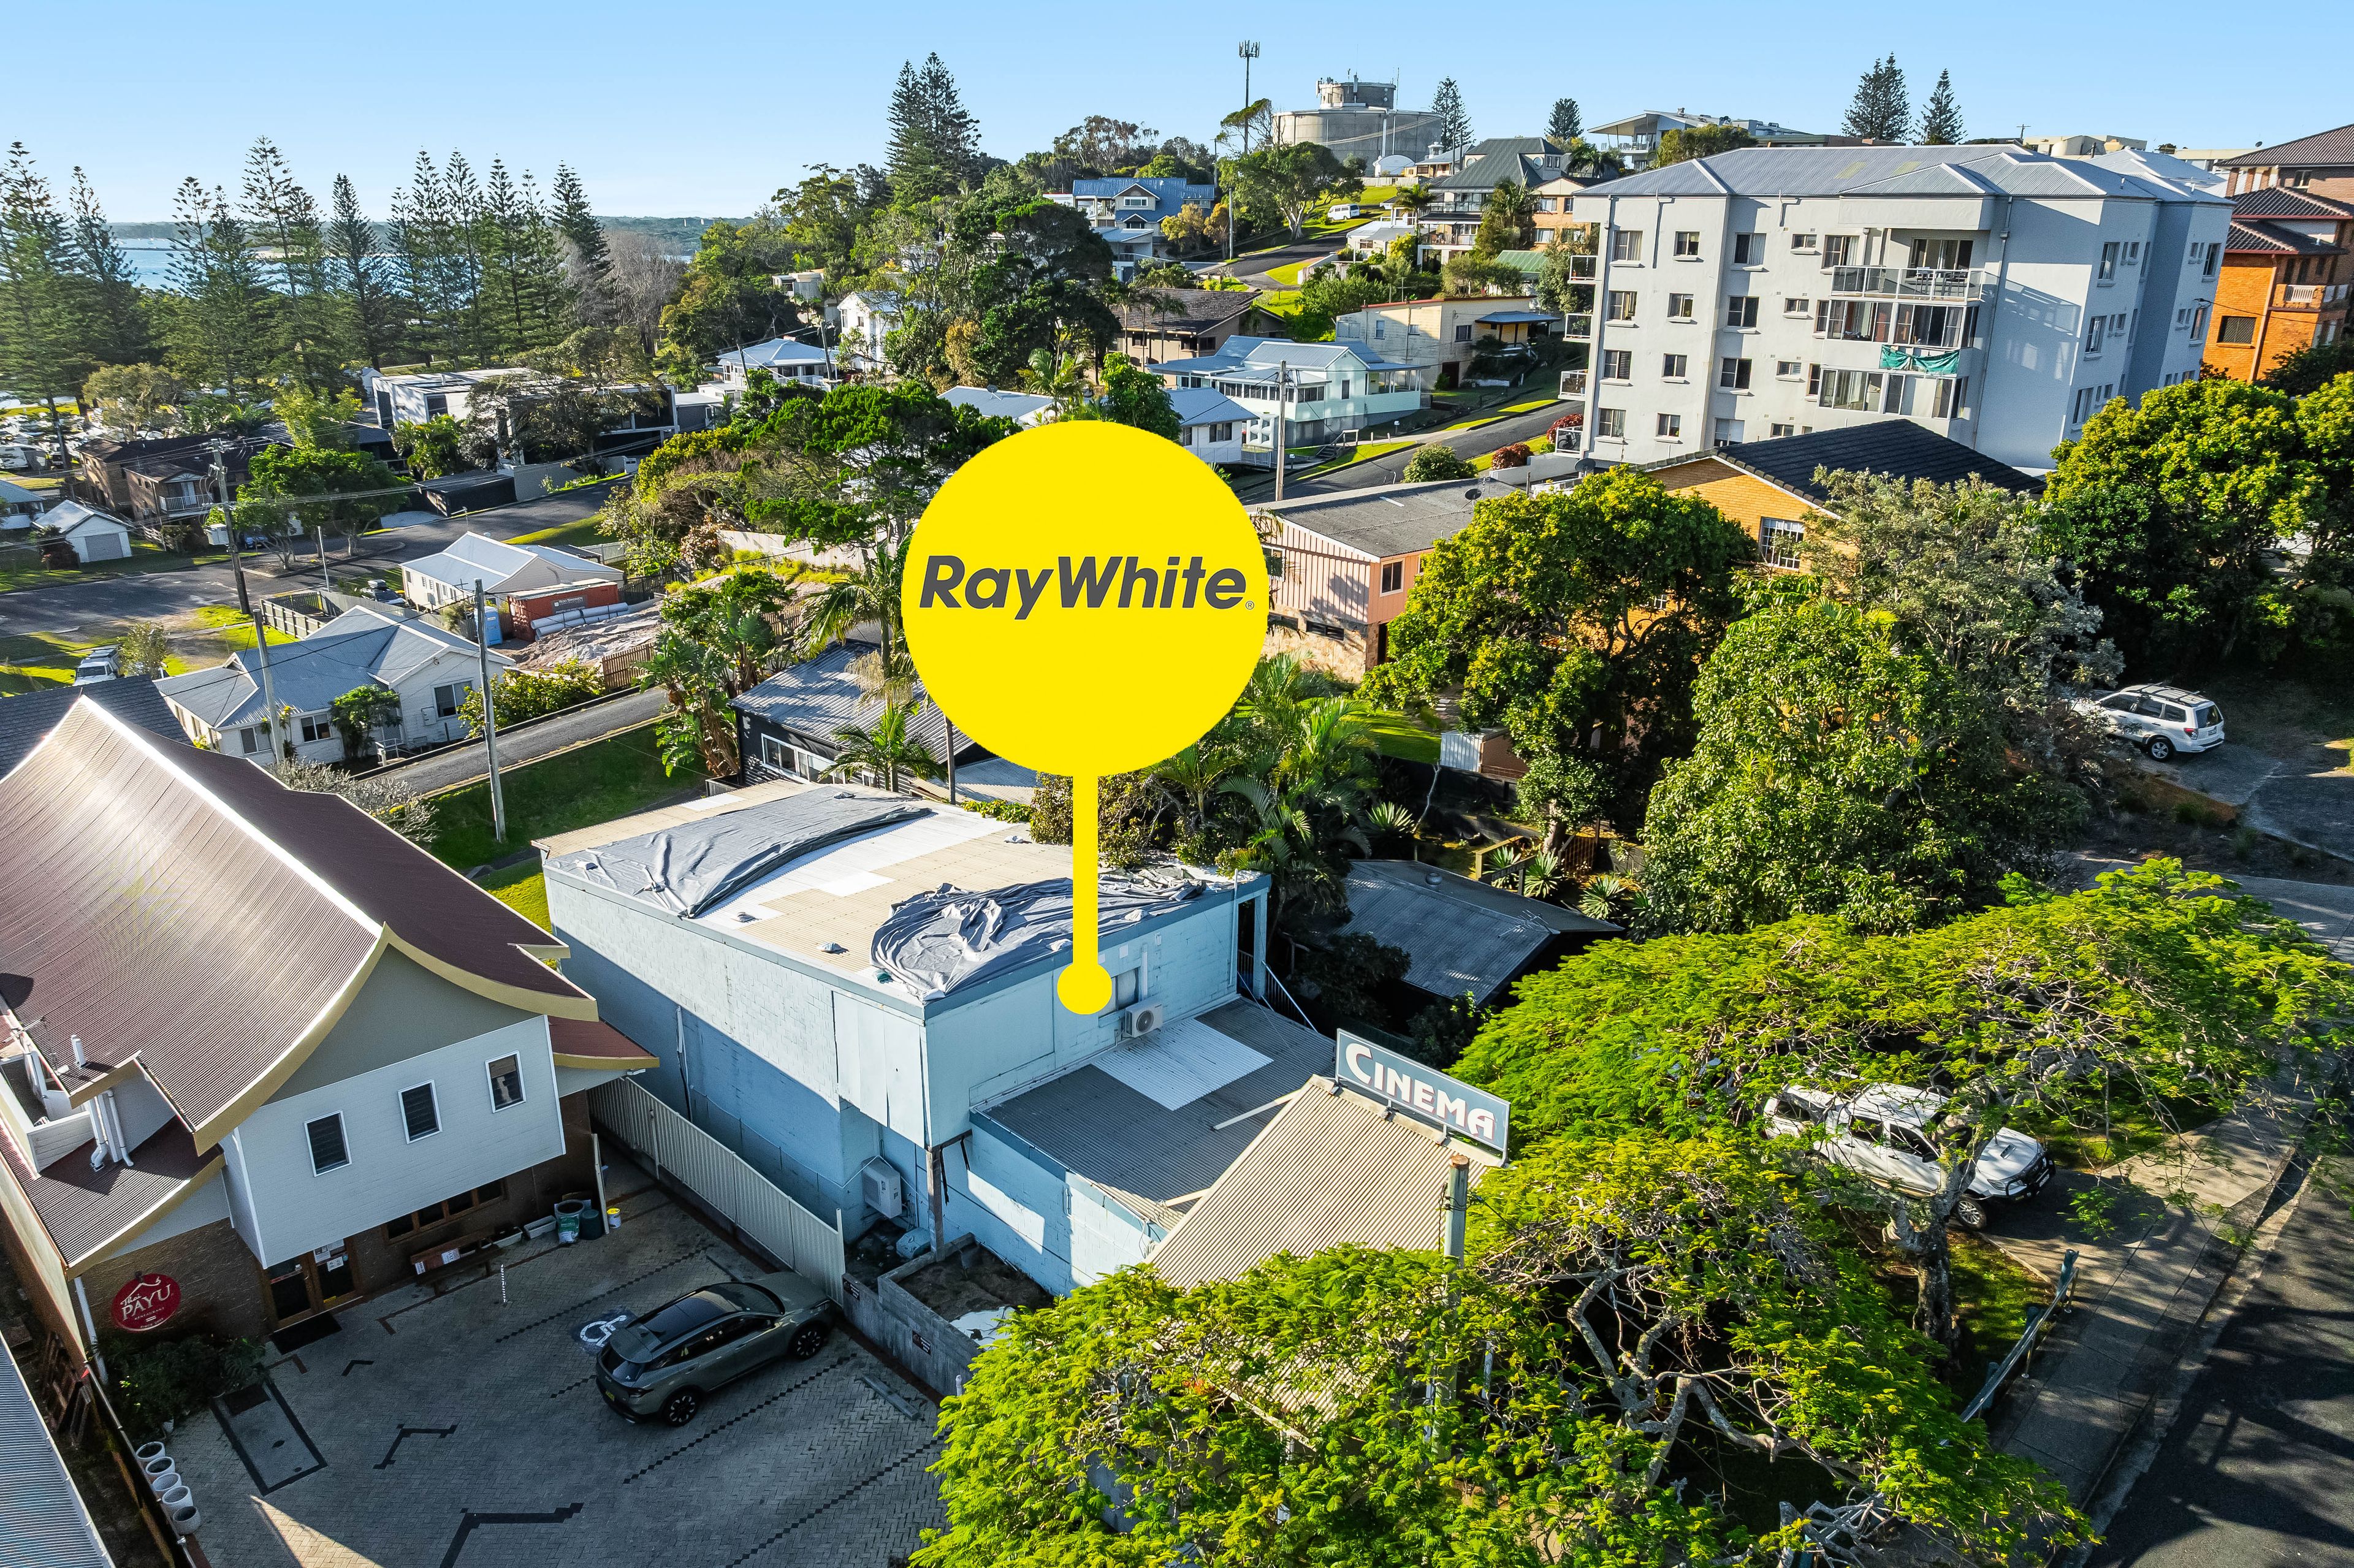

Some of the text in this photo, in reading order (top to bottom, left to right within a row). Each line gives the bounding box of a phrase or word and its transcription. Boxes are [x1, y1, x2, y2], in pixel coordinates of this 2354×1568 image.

[1345, 1043, 1496, 1140] CINEMA
[121, 1293, 142, 1306] Thai
[121, 1284, 171, 1321] PAYU
